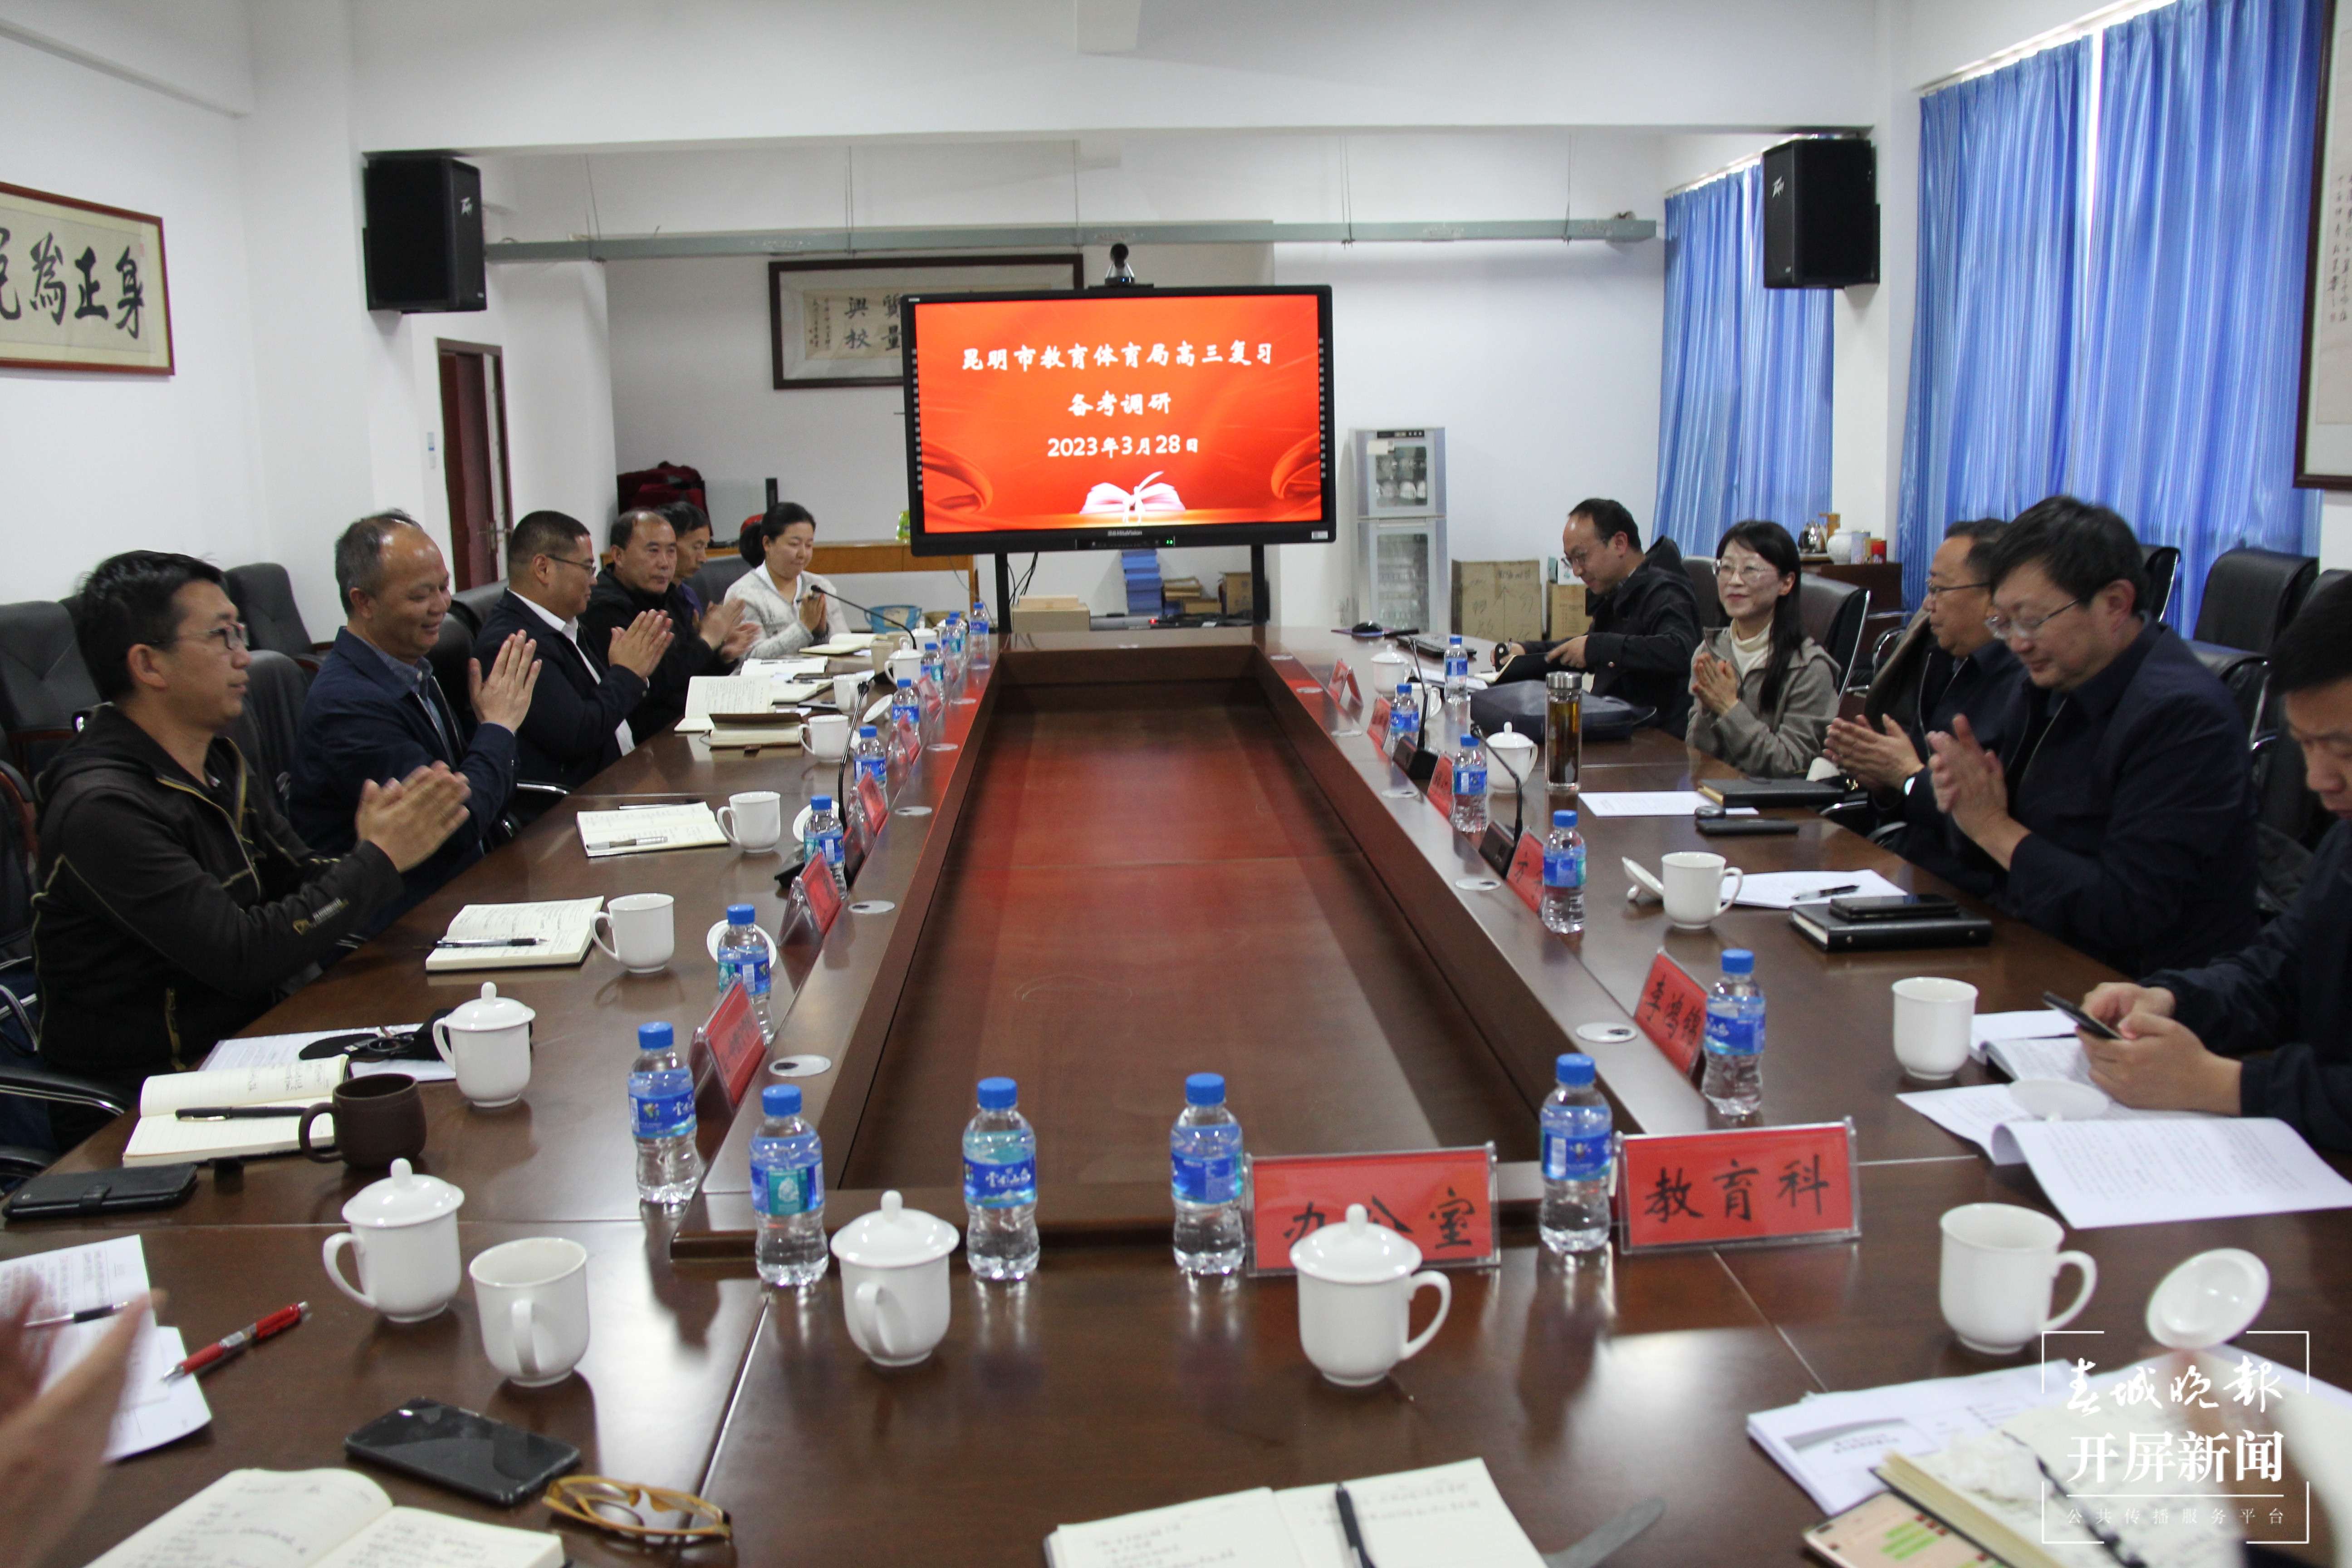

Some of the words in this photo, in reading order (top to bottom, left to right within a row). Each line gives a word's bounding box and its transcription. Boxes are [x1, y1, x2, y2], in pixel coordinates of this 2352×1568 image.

[962, 339, 1272, 372] 昆明市教育体育局高三复习
[1068, 390, 1171, 416] 备考调研
[1047, 434, 1199, 458] 2023年3月28日
[1643, 1153, 1830, 1222] 教育科
